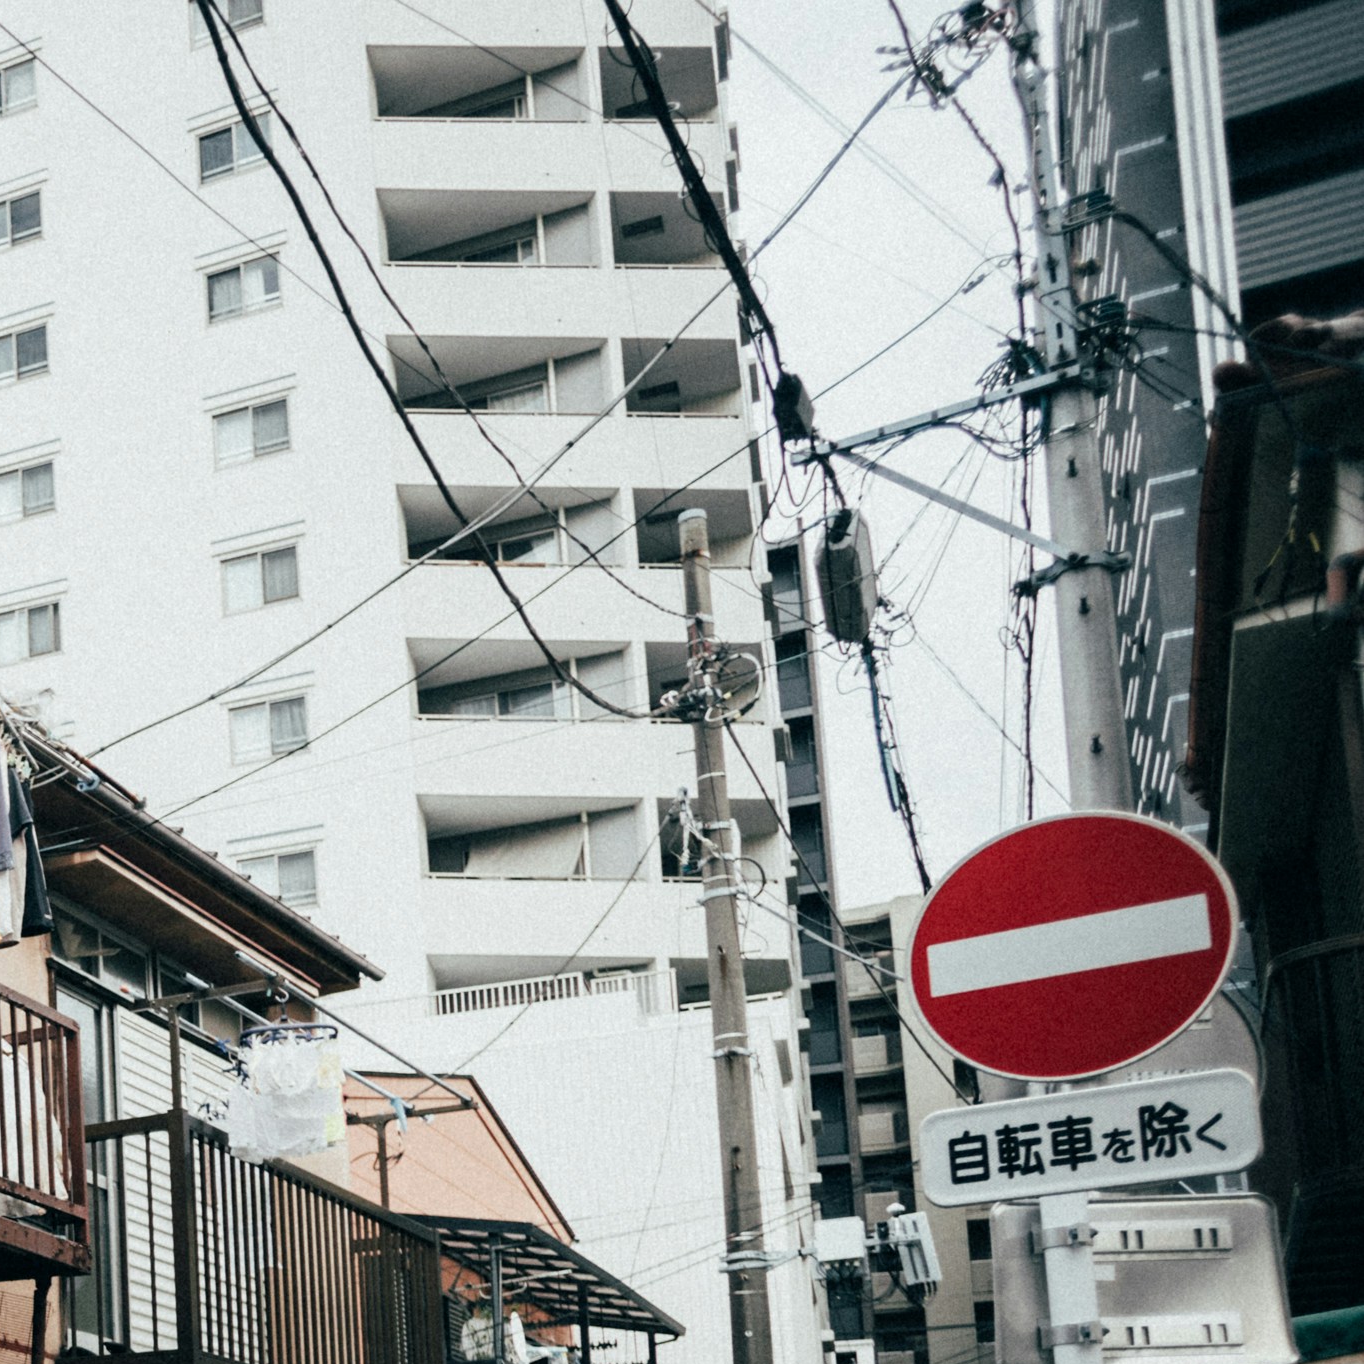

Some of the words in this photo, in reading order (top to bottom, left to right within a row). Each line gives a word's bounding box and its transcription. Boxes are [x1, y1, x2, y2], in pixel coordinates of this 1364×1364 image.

[948, 1101, 1227, 1184] 自転車を除く
